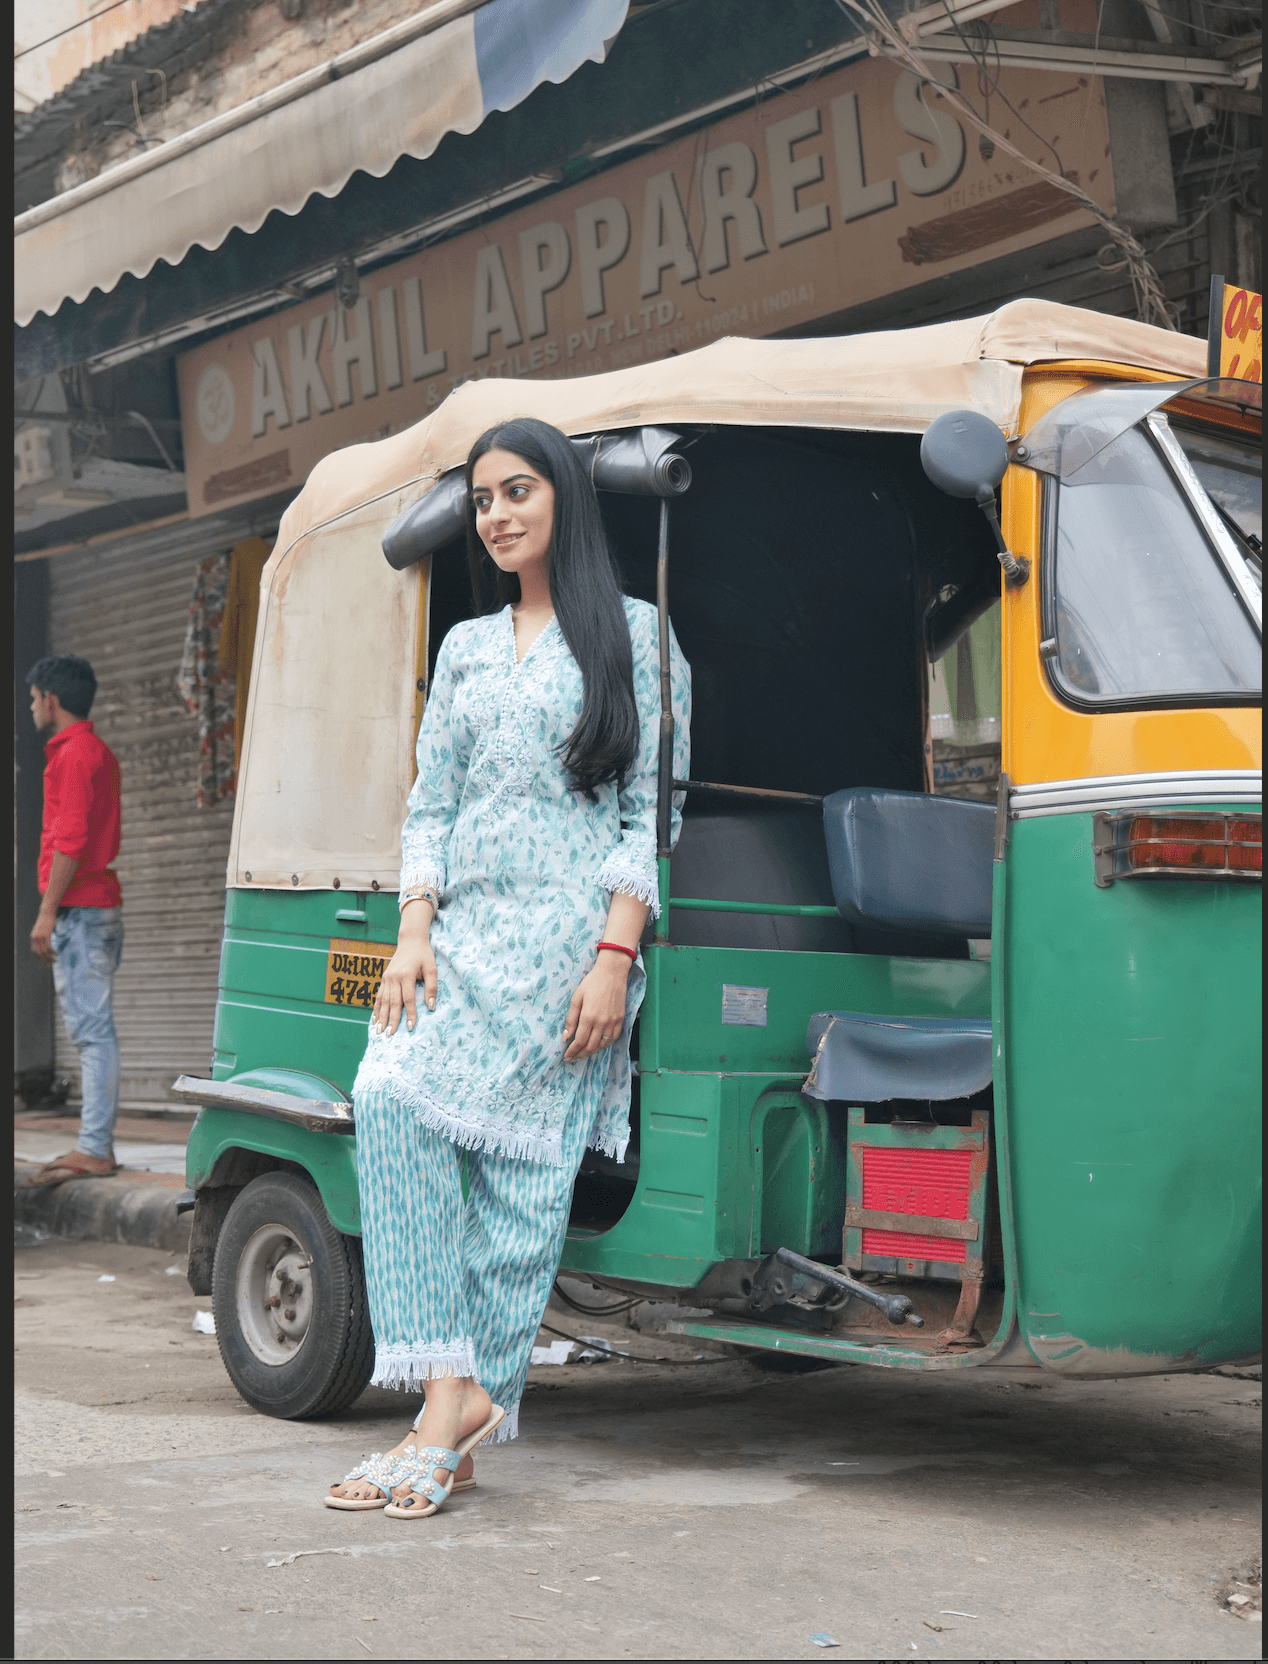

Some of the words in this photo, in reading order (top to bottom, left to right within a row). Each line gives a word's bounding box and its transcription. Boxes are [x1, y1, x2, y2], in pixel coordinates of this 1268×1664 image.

[252, 275, 447, 438] AKHIL
[472, 63, 966, 360] APPARELS
[426, 383, 441, 405] &
